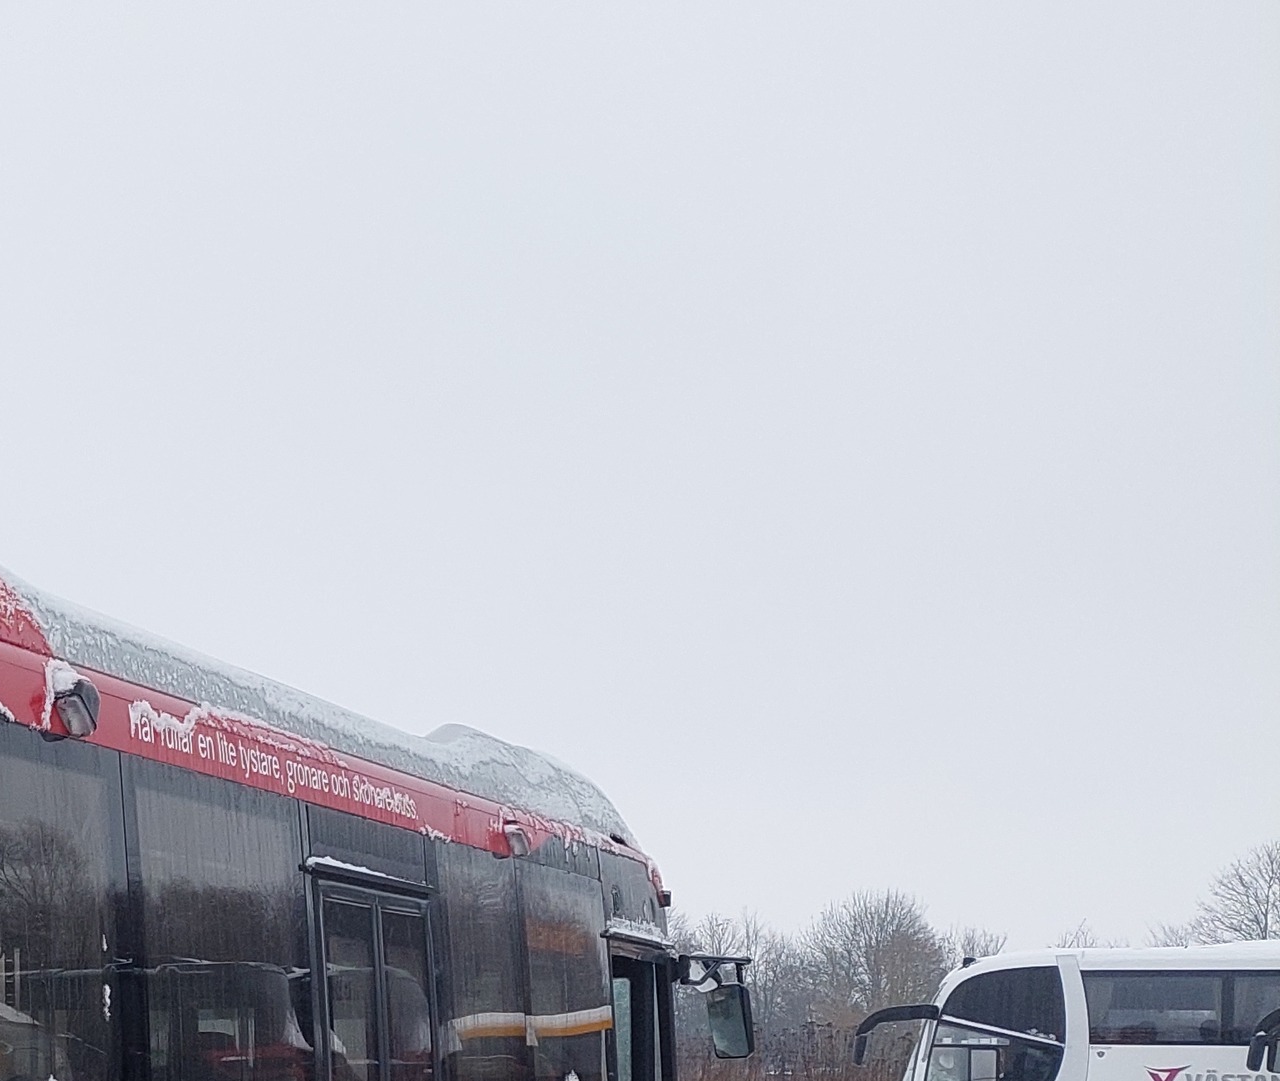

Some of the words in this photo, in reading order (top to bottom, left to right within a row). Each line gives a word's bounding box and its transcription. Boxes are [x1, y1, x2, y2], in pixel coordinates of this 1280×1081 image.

[198, 734, 215, 761] en
[216, 731, 236, 767] lite
[239, 740, 284, 785] tystare,
[286, 755, 329, 793] grönare
[331, 769, 351, 798] och
